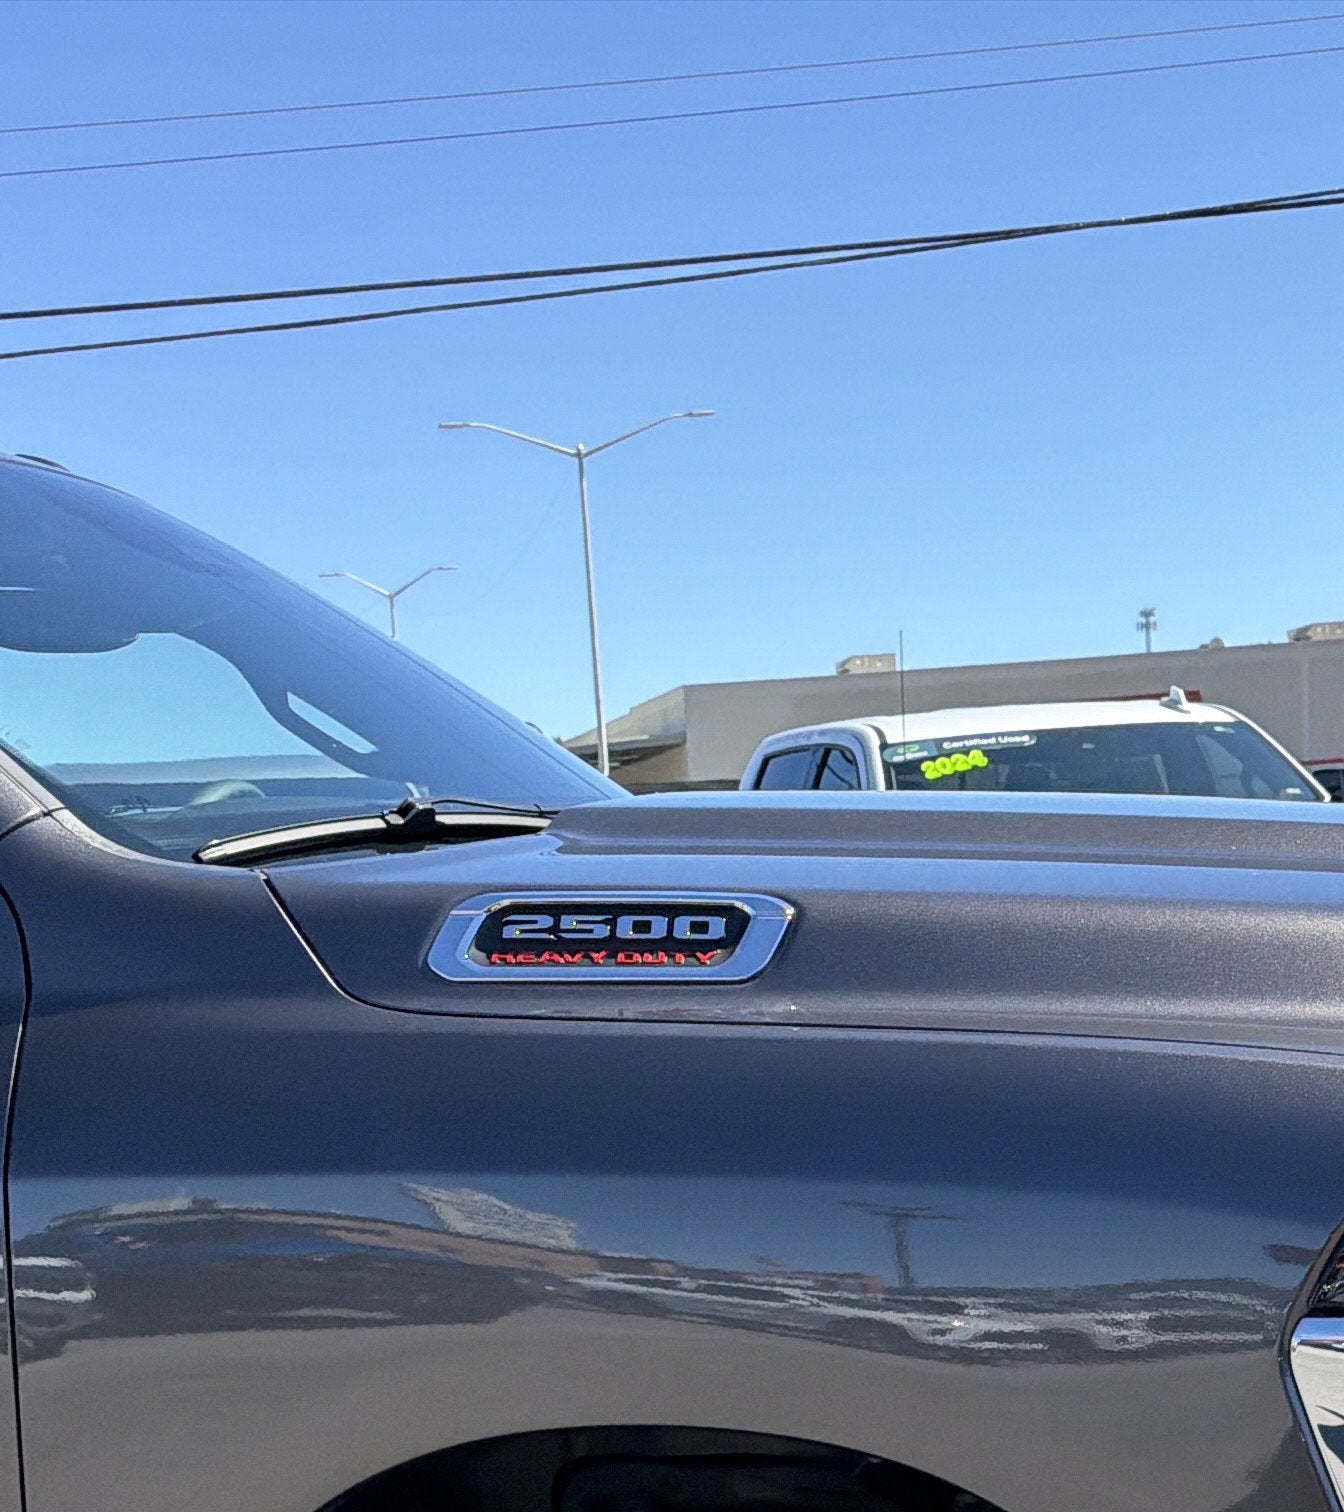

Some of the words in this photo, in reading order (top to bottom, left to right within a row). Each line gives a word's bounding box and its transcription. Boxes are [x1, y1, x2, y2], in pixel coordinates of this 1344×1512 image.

[942, 736, 997, 750] Certified
[998, 734, 1030, 744] Used
[920, 749, 989, 780] 2024
[501, 914, 726, 940] 2500
[490, 951, 609, 965] HEAVY
[616, 949, 722, 965] DUTY
